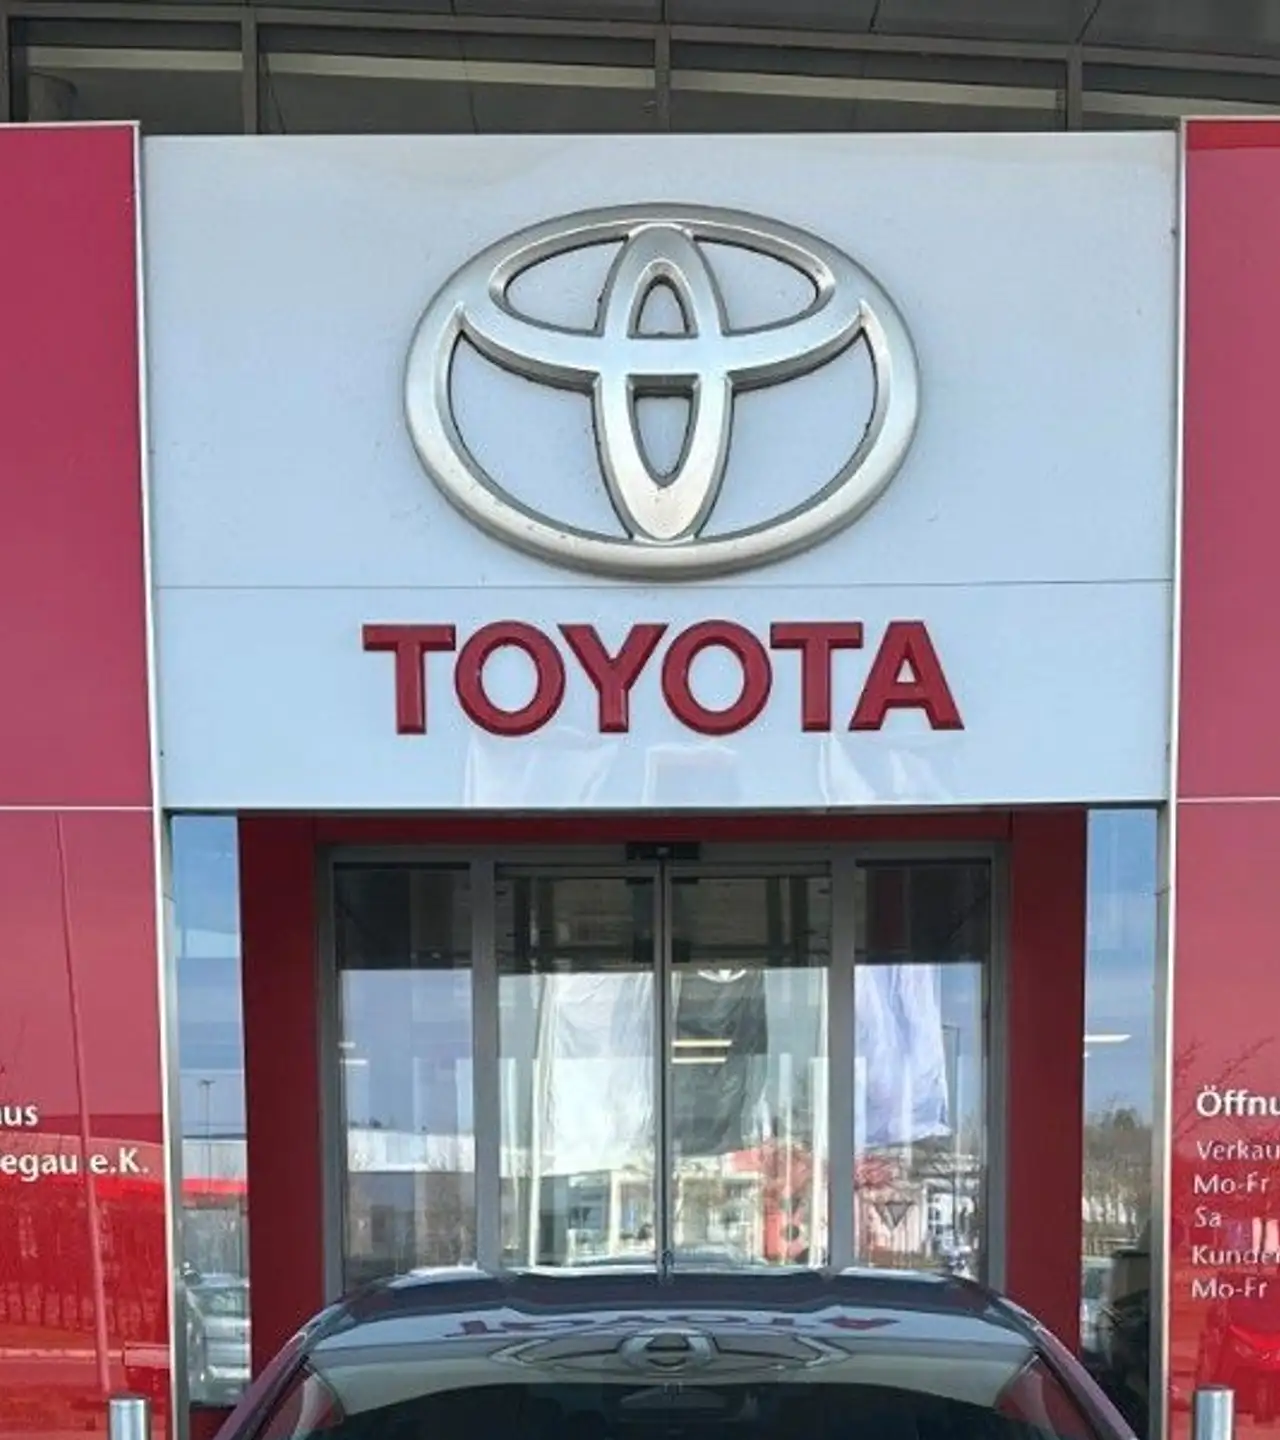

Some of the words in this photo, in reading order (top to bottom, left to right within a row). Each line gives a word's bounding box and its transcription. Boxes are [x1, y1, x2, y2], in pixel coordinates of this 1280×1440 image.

[362, 619, 964, 737] TOYOTA
[90, 1147, 149, 1174] e.K.
[1193, 1172, 1270, 1194] Mo-Fr
[1194, 1206, 1221, 1228] Sa
[1191, 1277, 1269, 1299] Mo-Fr
